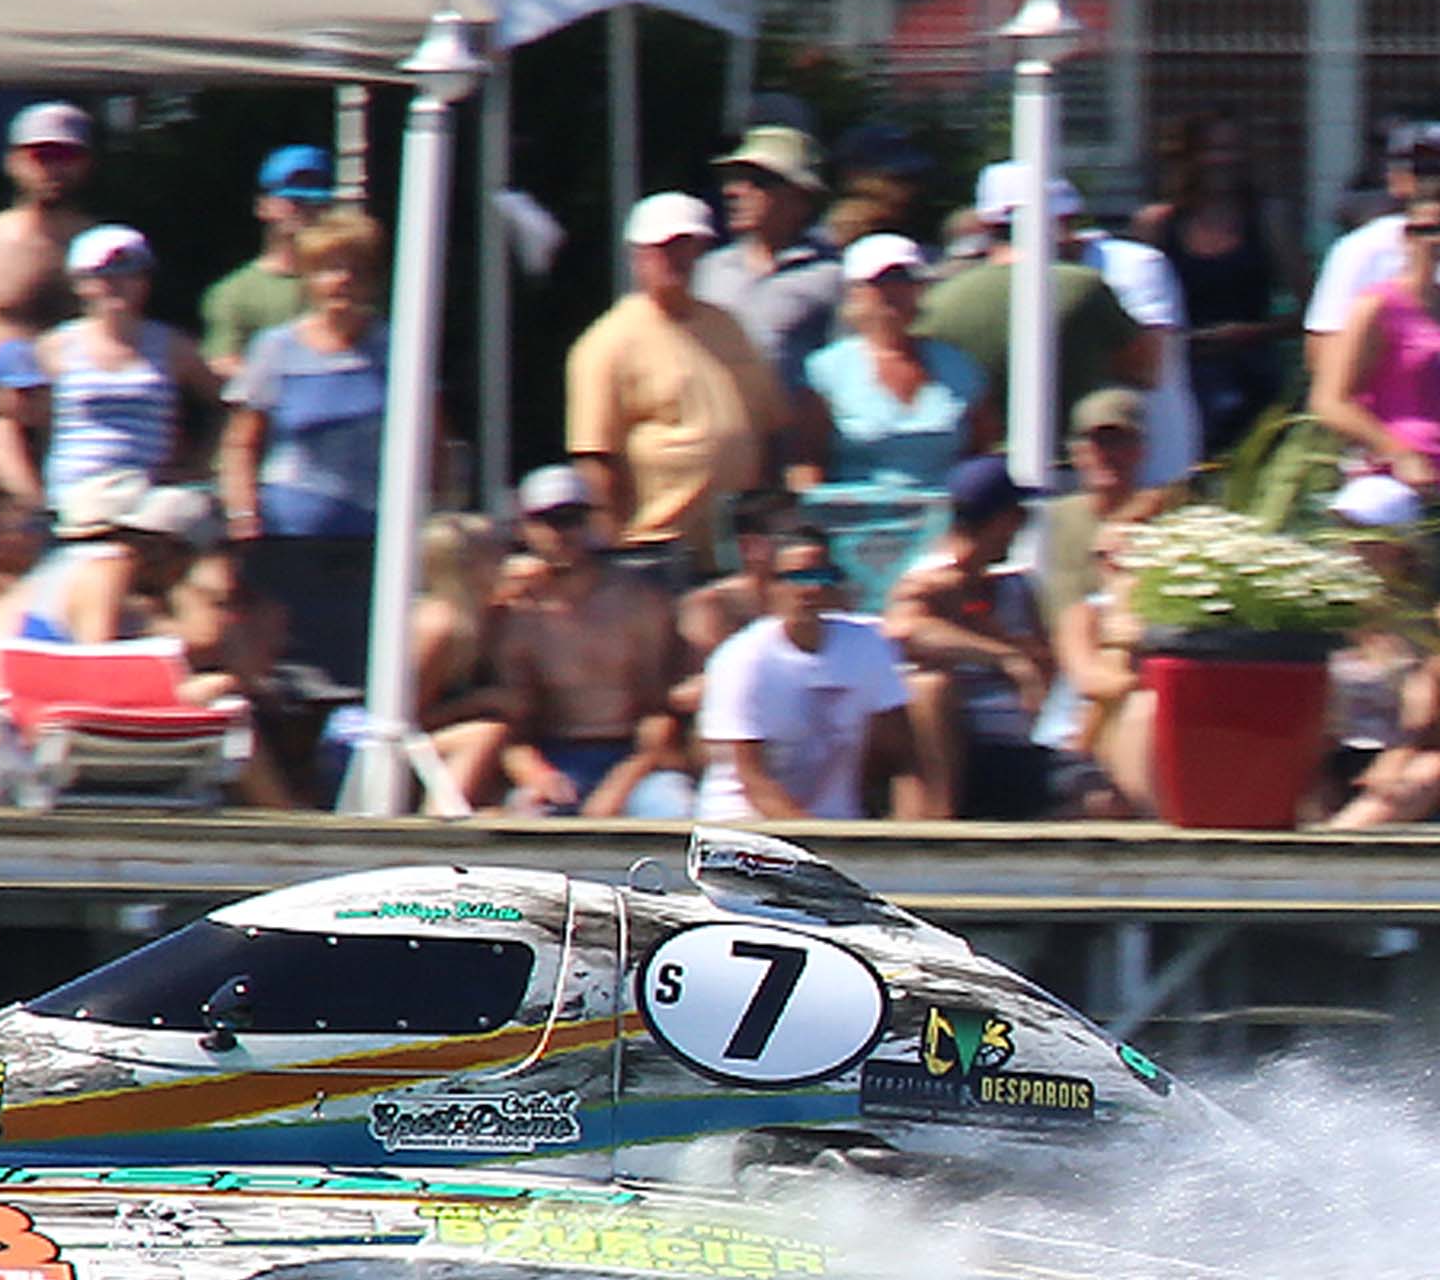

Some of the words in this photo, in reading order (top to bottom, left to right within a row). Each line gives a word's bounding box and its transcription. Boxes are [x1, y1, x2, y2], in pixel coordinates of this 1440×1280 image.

[656, 964, 684, 1004] S
[723, 941, 808, 1061] 7
[981, 1077, 1091, 1109] DESPAROIS
[438, 1218, 828, 1275] BOURCIER
